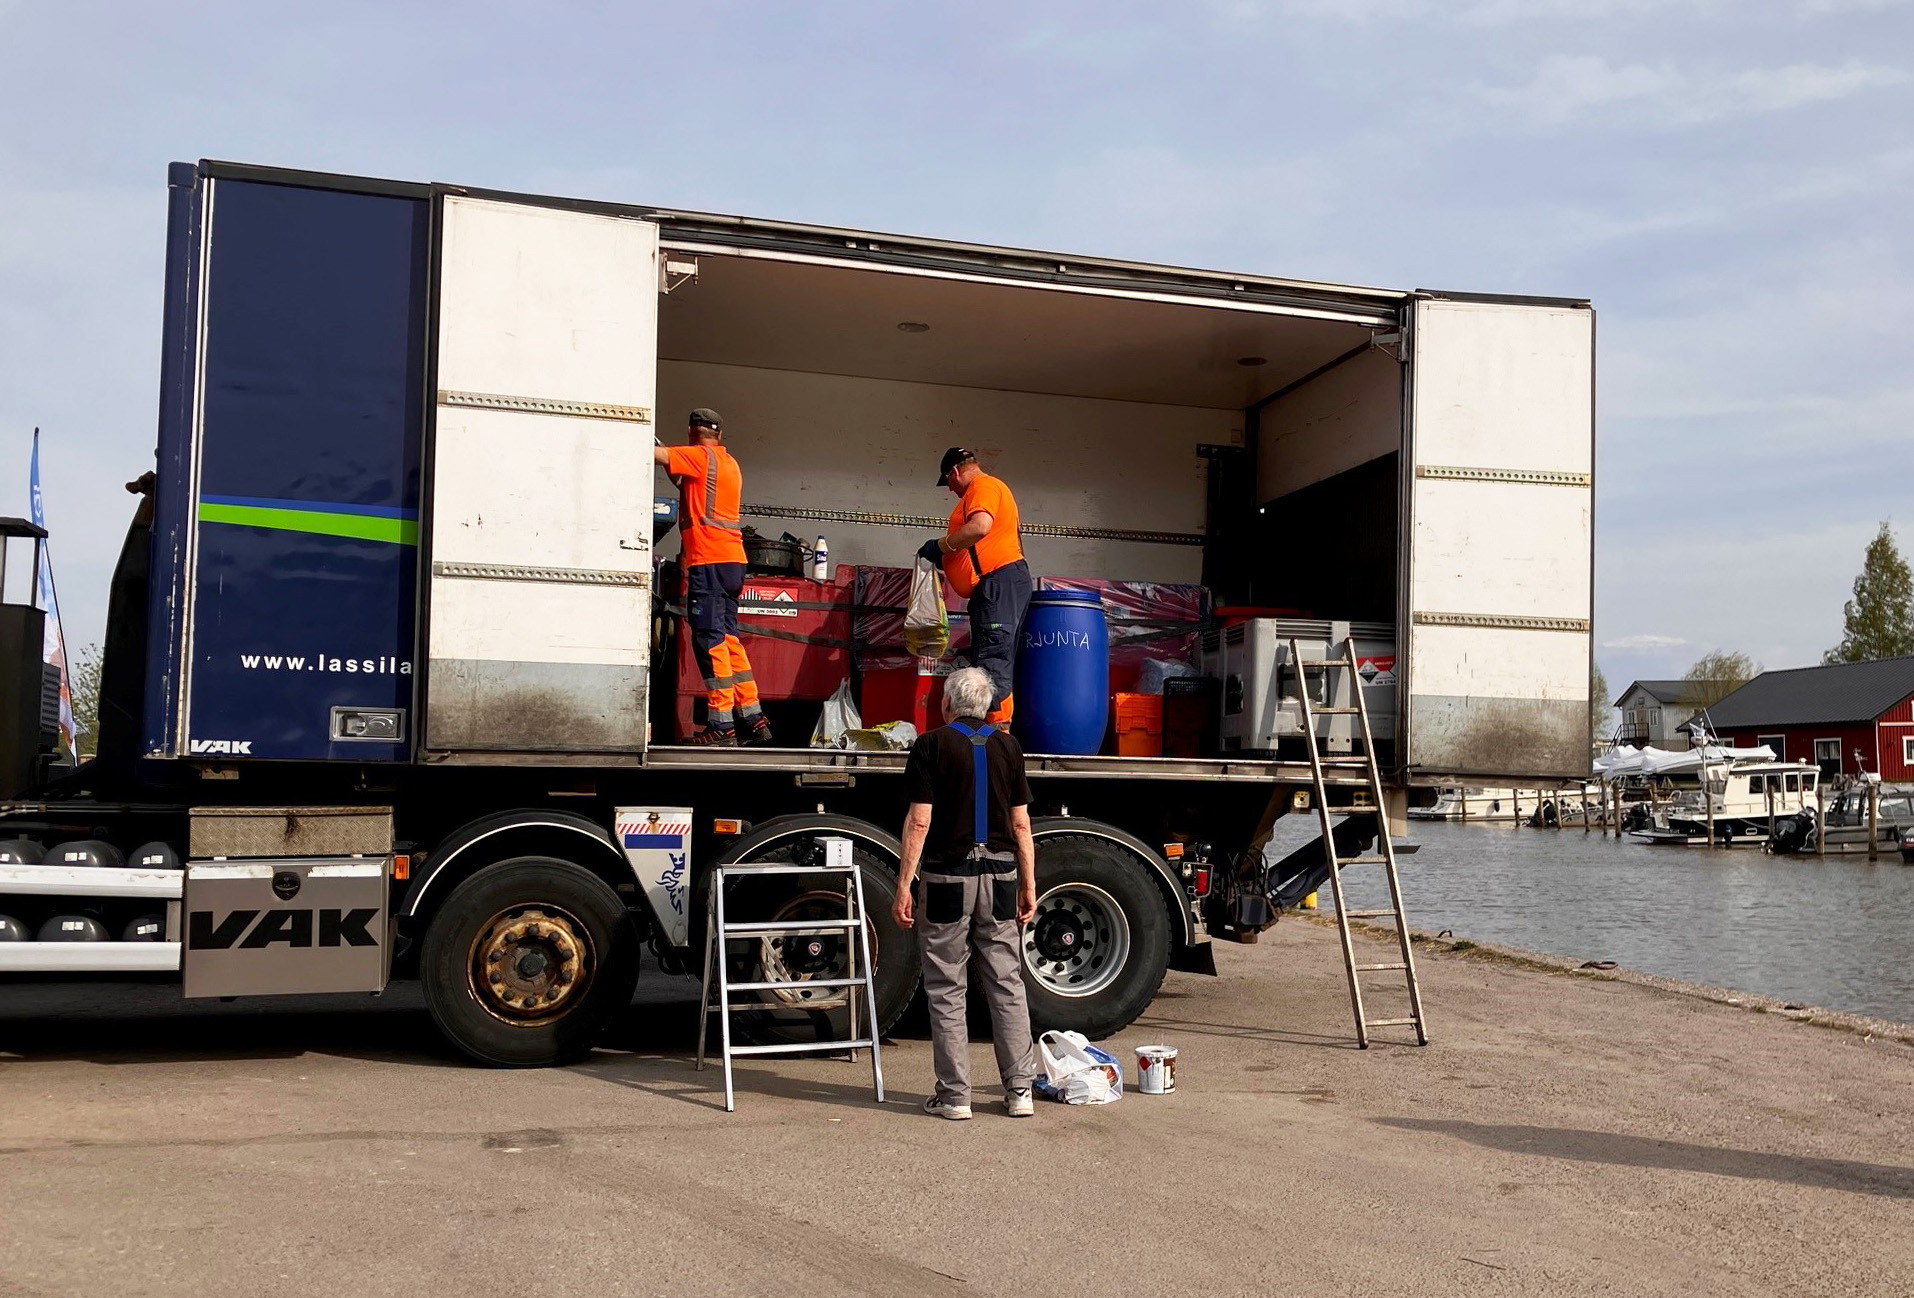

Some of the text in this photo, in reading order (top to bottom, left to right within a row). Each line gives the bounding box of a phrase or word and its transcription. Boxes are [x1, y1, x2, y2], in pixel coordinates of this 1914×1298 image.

[240, 653, 412, 675] www.lassila
[190, 739, 253, 755] VAK
[189, 908, 380, 950] VAK
